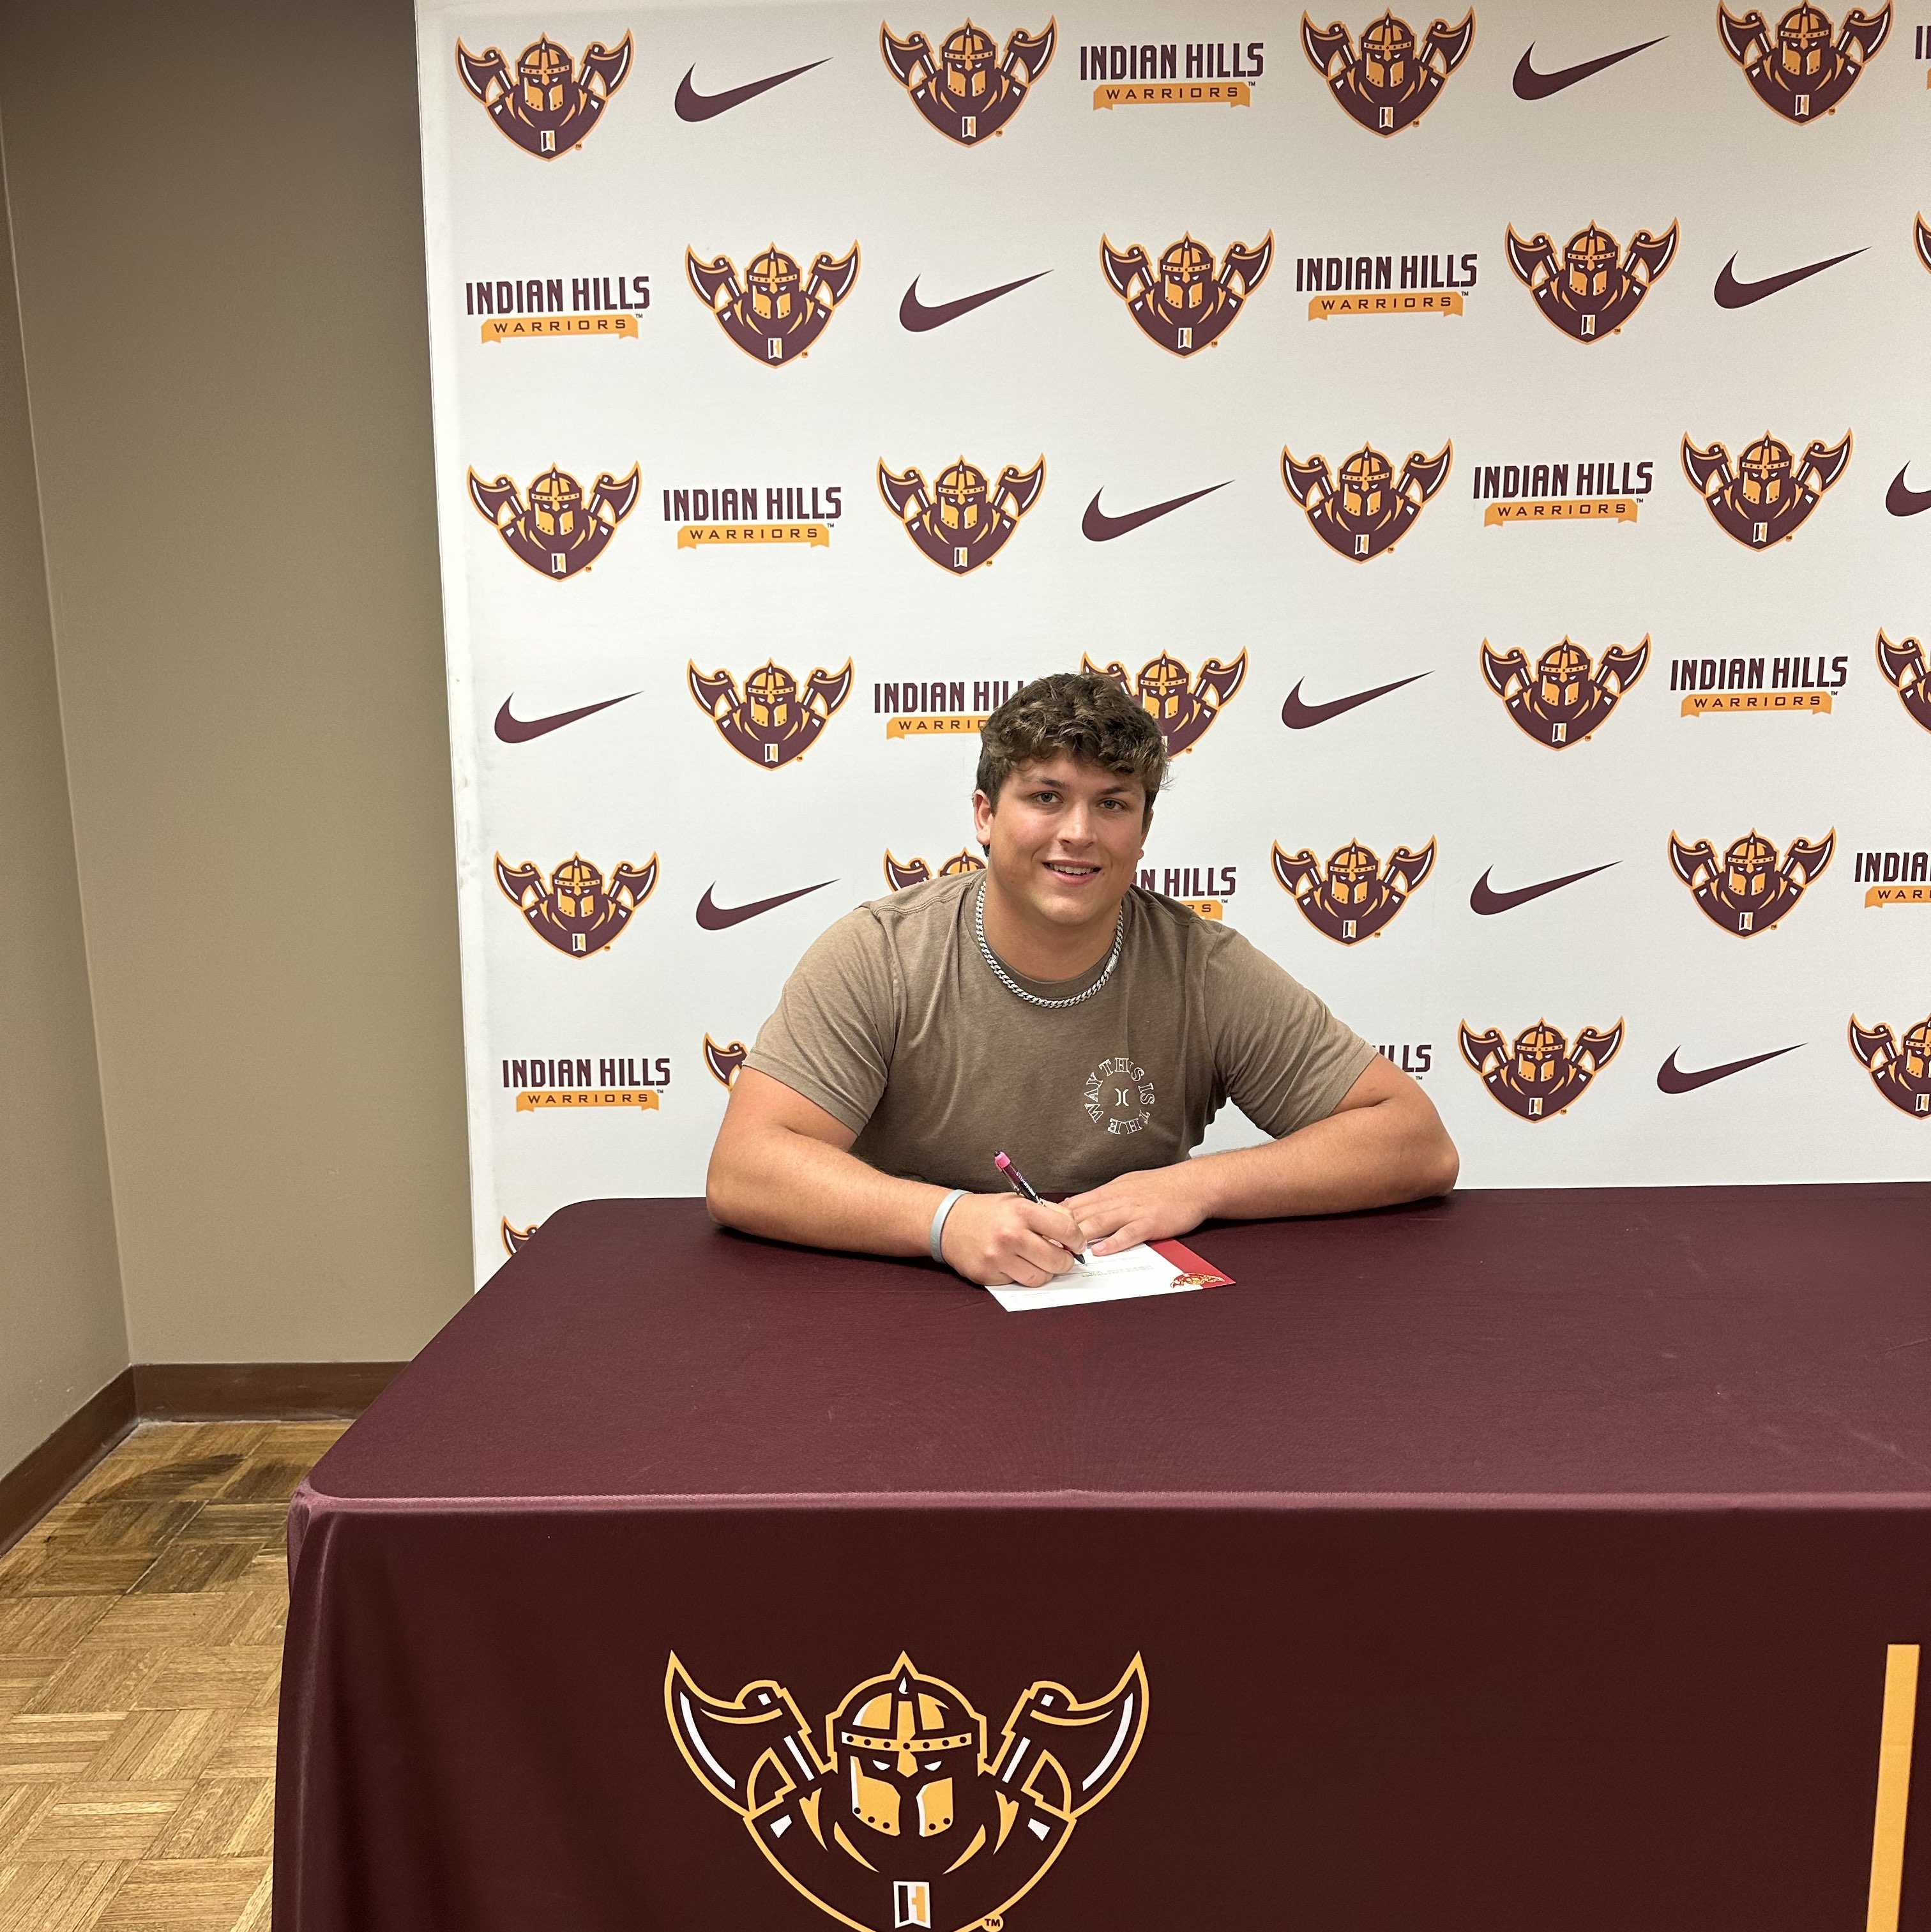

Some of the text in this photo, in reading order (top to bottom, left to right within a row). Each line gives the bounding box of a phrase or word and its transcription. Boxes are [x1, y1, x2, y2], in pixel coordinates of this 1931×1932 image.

[1080, 42, 1264, 80] INDIAN HILLS
[1105, 86, 1238, 100] WARRIORS
[1296, 254, 1478, 292] INDIAN HILLS
[466, 276, 650, 316] INDIAN HILLS
[1321, 296, 1451, 310] WARRIORS
[494, 319, 626, 333] WARRIORS
[1473, 461, 1653, 499] INDIAN HILLS
[663, 487, 842, 522] INDIAN HILLS
[1497, 503, 1626, 517] WARRIORS
[689, 528, 817, 540] WARRIORS
[1670, 656, 1849, 691] INDIAN HILLS
[874, 681, 965, 713] INDIAN
[1693, 696, 1821, 708] WARRIORS
[898, 720, 987, 730] WARRI
[1164, 867, 1236, 897] HILLS
[1854, 852, 1931, 883] INDIA
[503, 1058, 670, 1088] INDIAN HILLS
[527, 1093, 647, 1104] WARRIORS
[1084, 1072, 1103, 1123] WAY
[1138, 1083, 1155, 1105] IS
